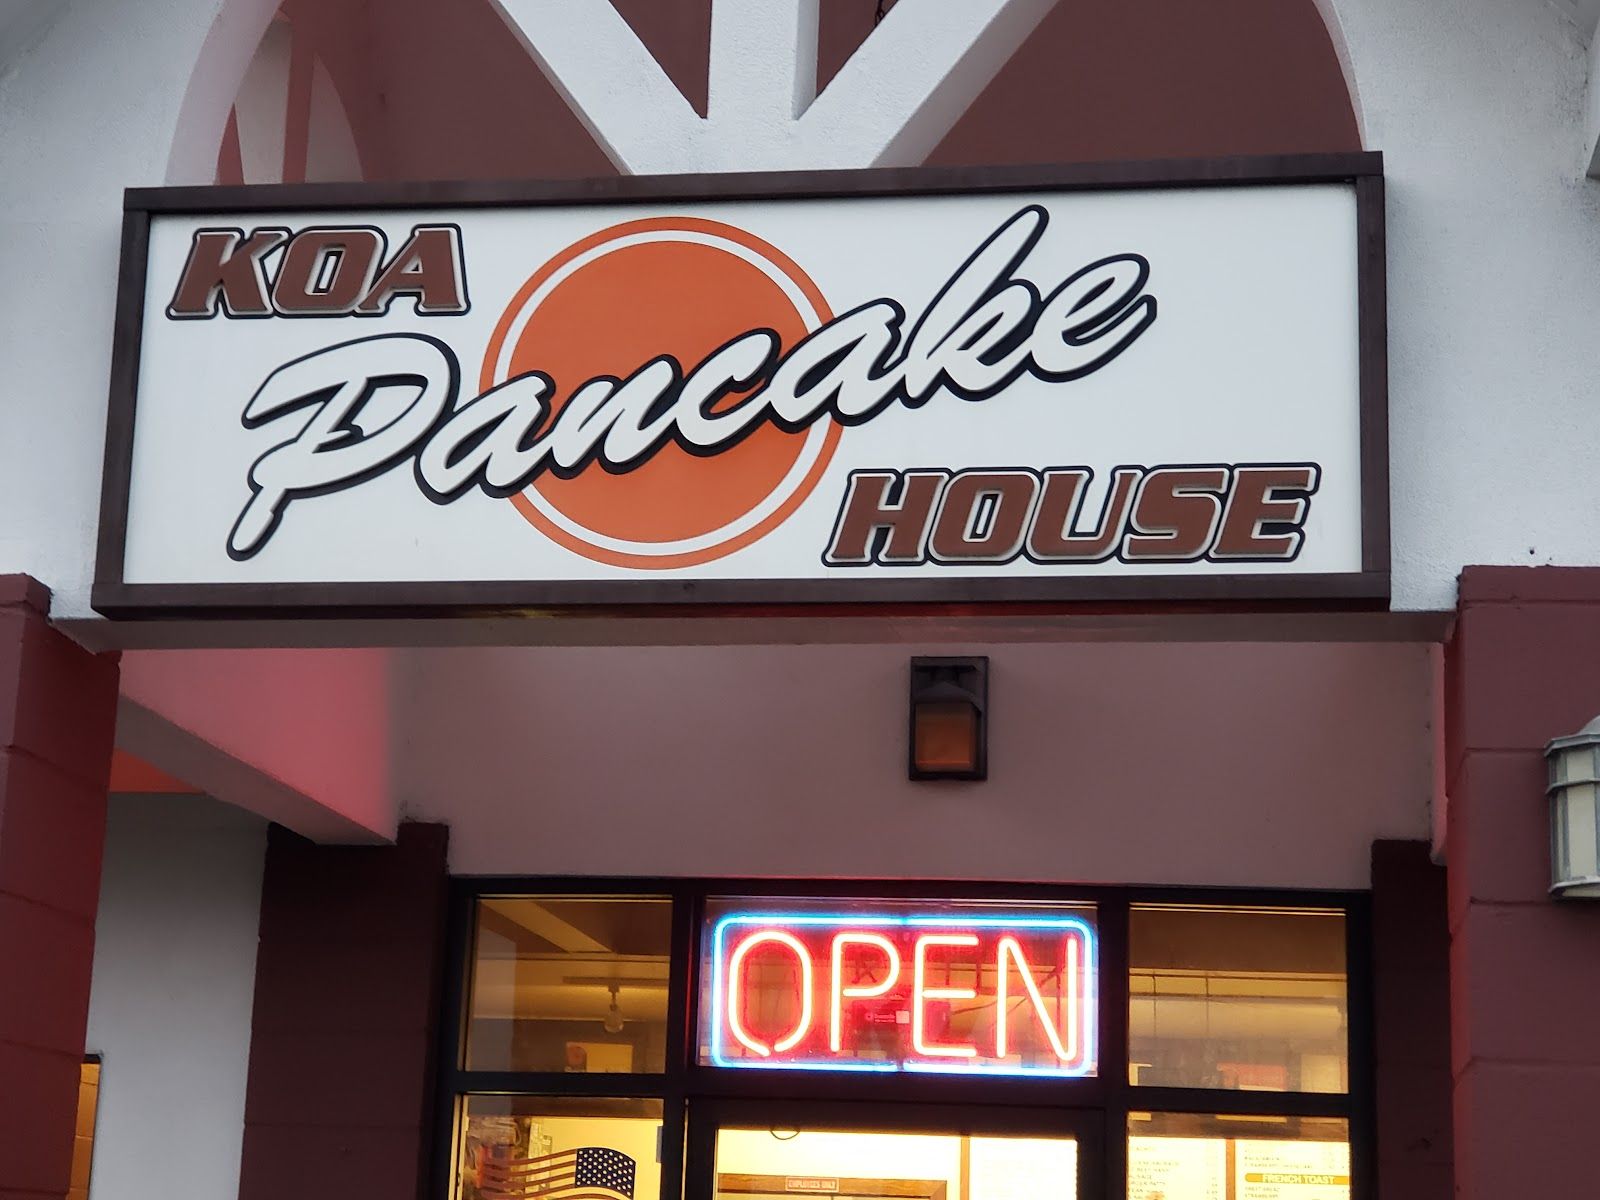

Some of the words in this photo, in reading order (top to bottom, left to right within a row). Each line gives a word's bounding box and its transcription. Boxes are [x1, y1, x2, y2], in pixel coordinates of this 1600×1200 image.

[165, 223, 471, 320] KOA
[226, 204, 1157, 561] Pancake
[821, 462, 1321, 565] HOUSE
[727, 930, 1078, 1061] OPEN
[1262, 1174, 1302, 1185] FRENCH
[1303, 1175, 1334, 1185] TOAST
